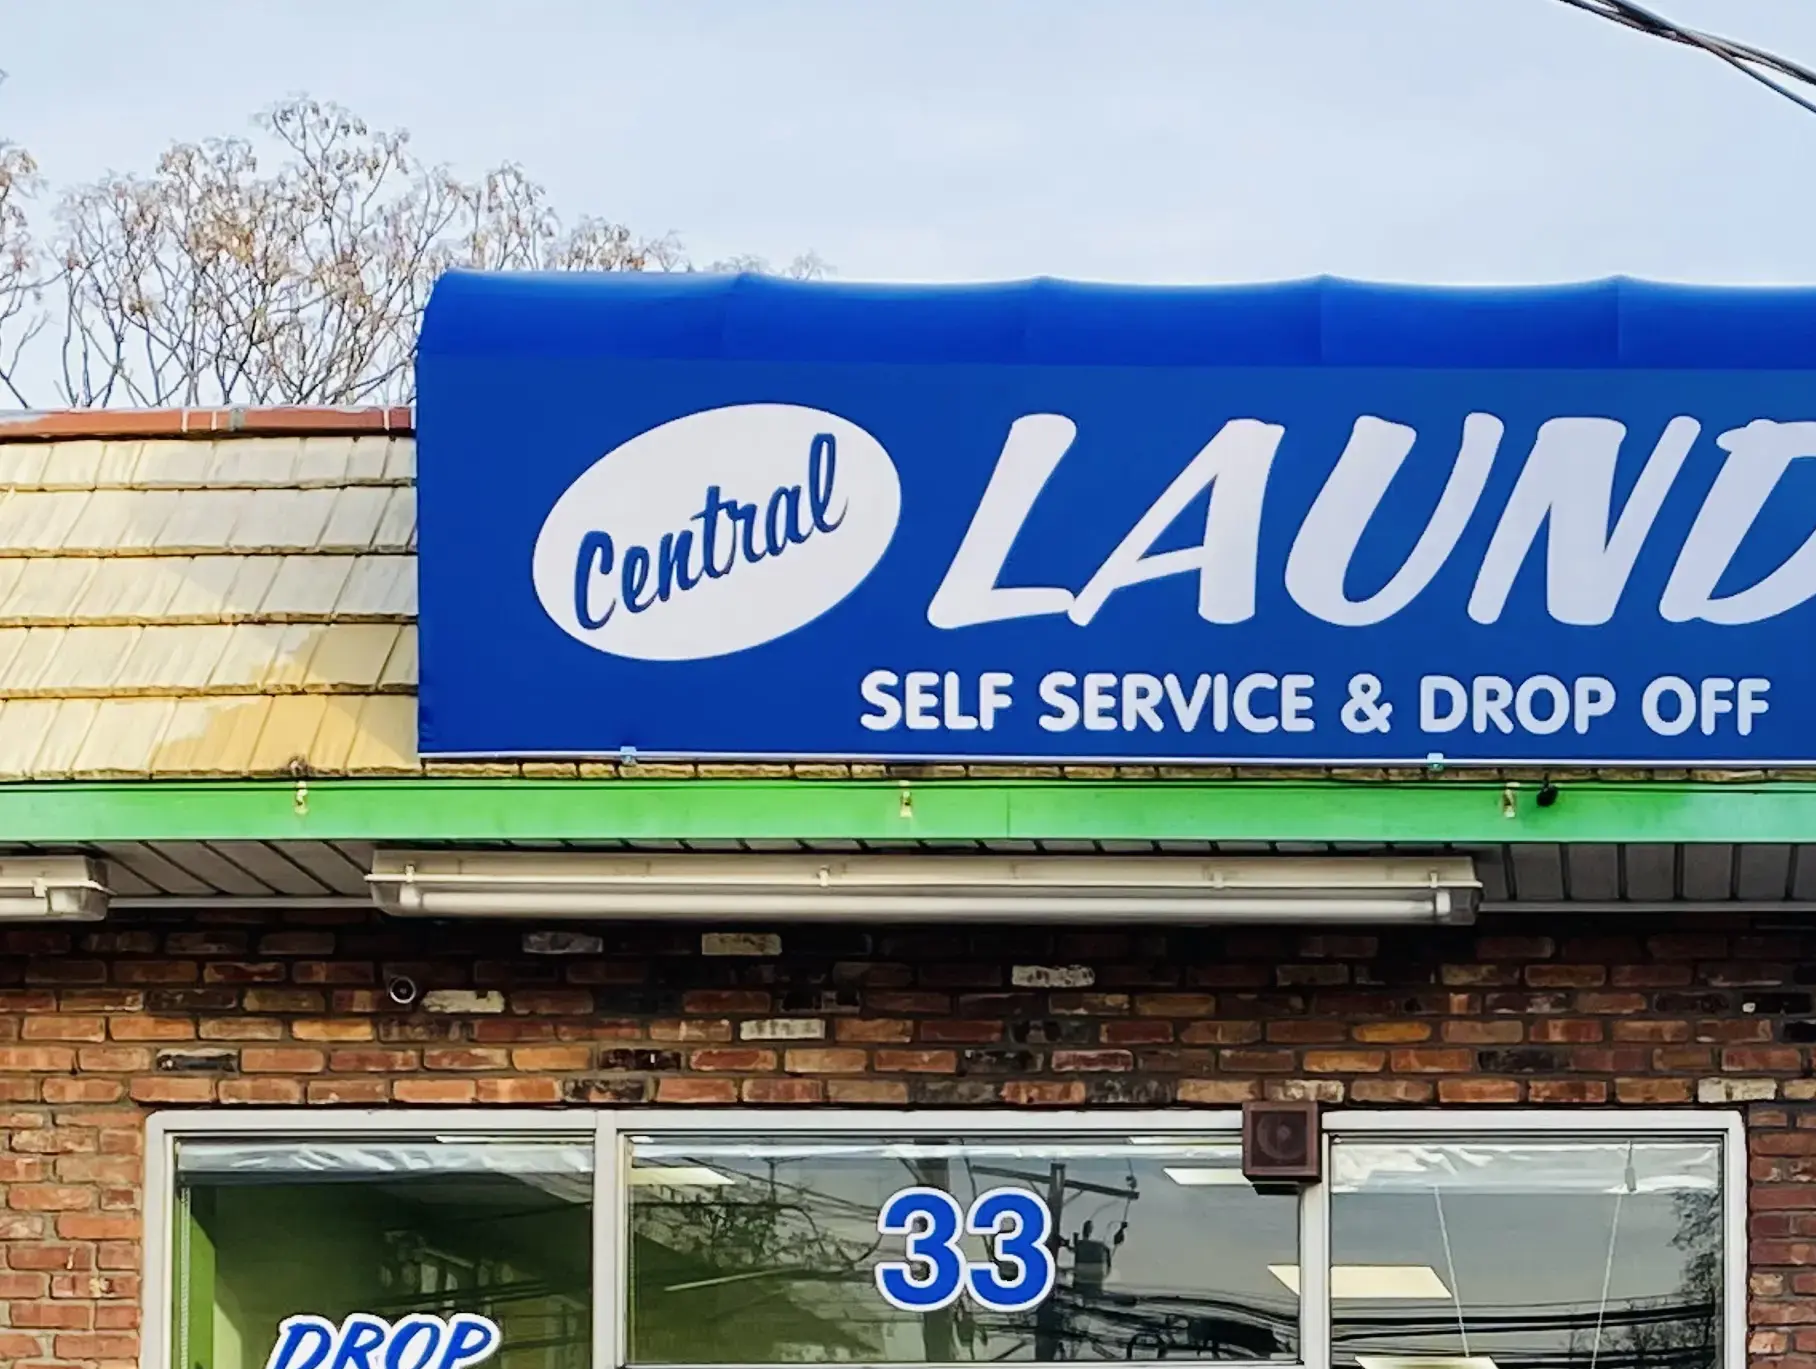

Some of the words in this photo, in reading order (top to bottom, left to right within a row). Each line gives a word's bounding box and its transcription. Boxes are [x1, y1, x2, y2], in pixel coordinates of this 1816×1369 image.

[574, 433, 848, 631] Central
[859, 669, 1013, 733] SELF
[1037, 670, 1316, 734] SERVICE
[1340, 672, 1394, 735] &
[1418, 674, 1617, 736] DROP
[1640, 676, 1772, 737] OFF
[877, 1189, 1054, 1309] 33
